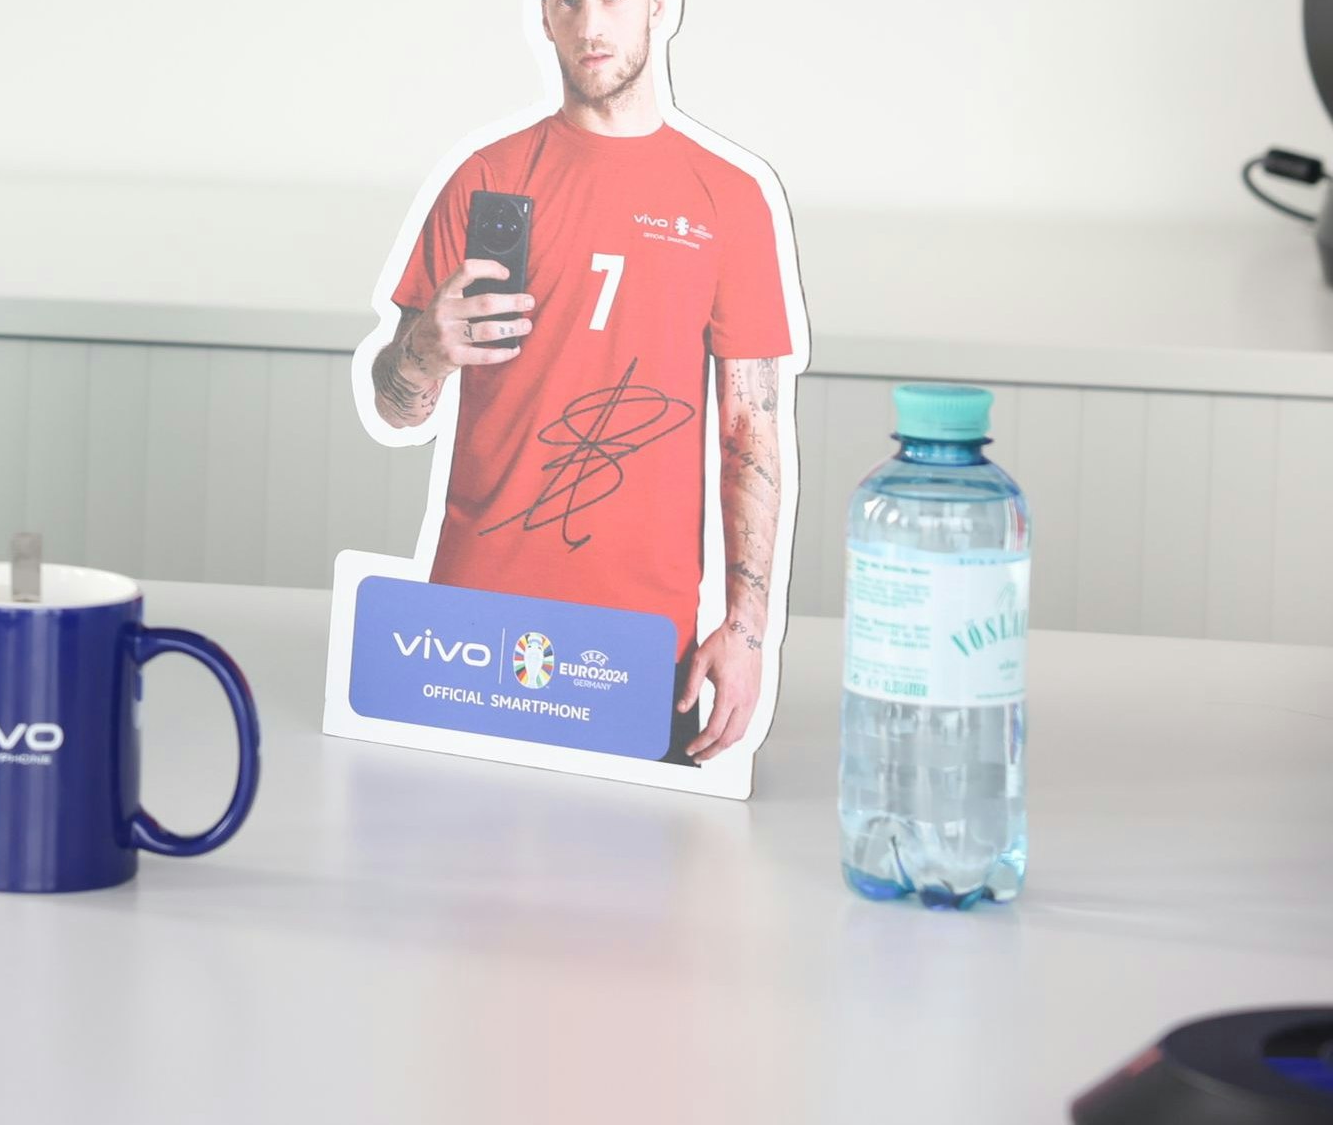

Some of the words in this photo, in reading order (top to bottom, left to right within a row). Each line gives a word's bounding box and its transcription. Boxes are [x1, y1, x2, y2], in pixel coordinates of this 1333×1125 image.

[633, 214, 669, 228] vivo
[589, 252, 625, 331] 7
[393, 628, 491, 667] vivo
[581, 651, 607, 665] UEFA
[573, 678, 612, 691] GERMANY
[422, 684, 485, 706] OFFICIAL
[490, 694, 591, 721] SMARTPHONE
